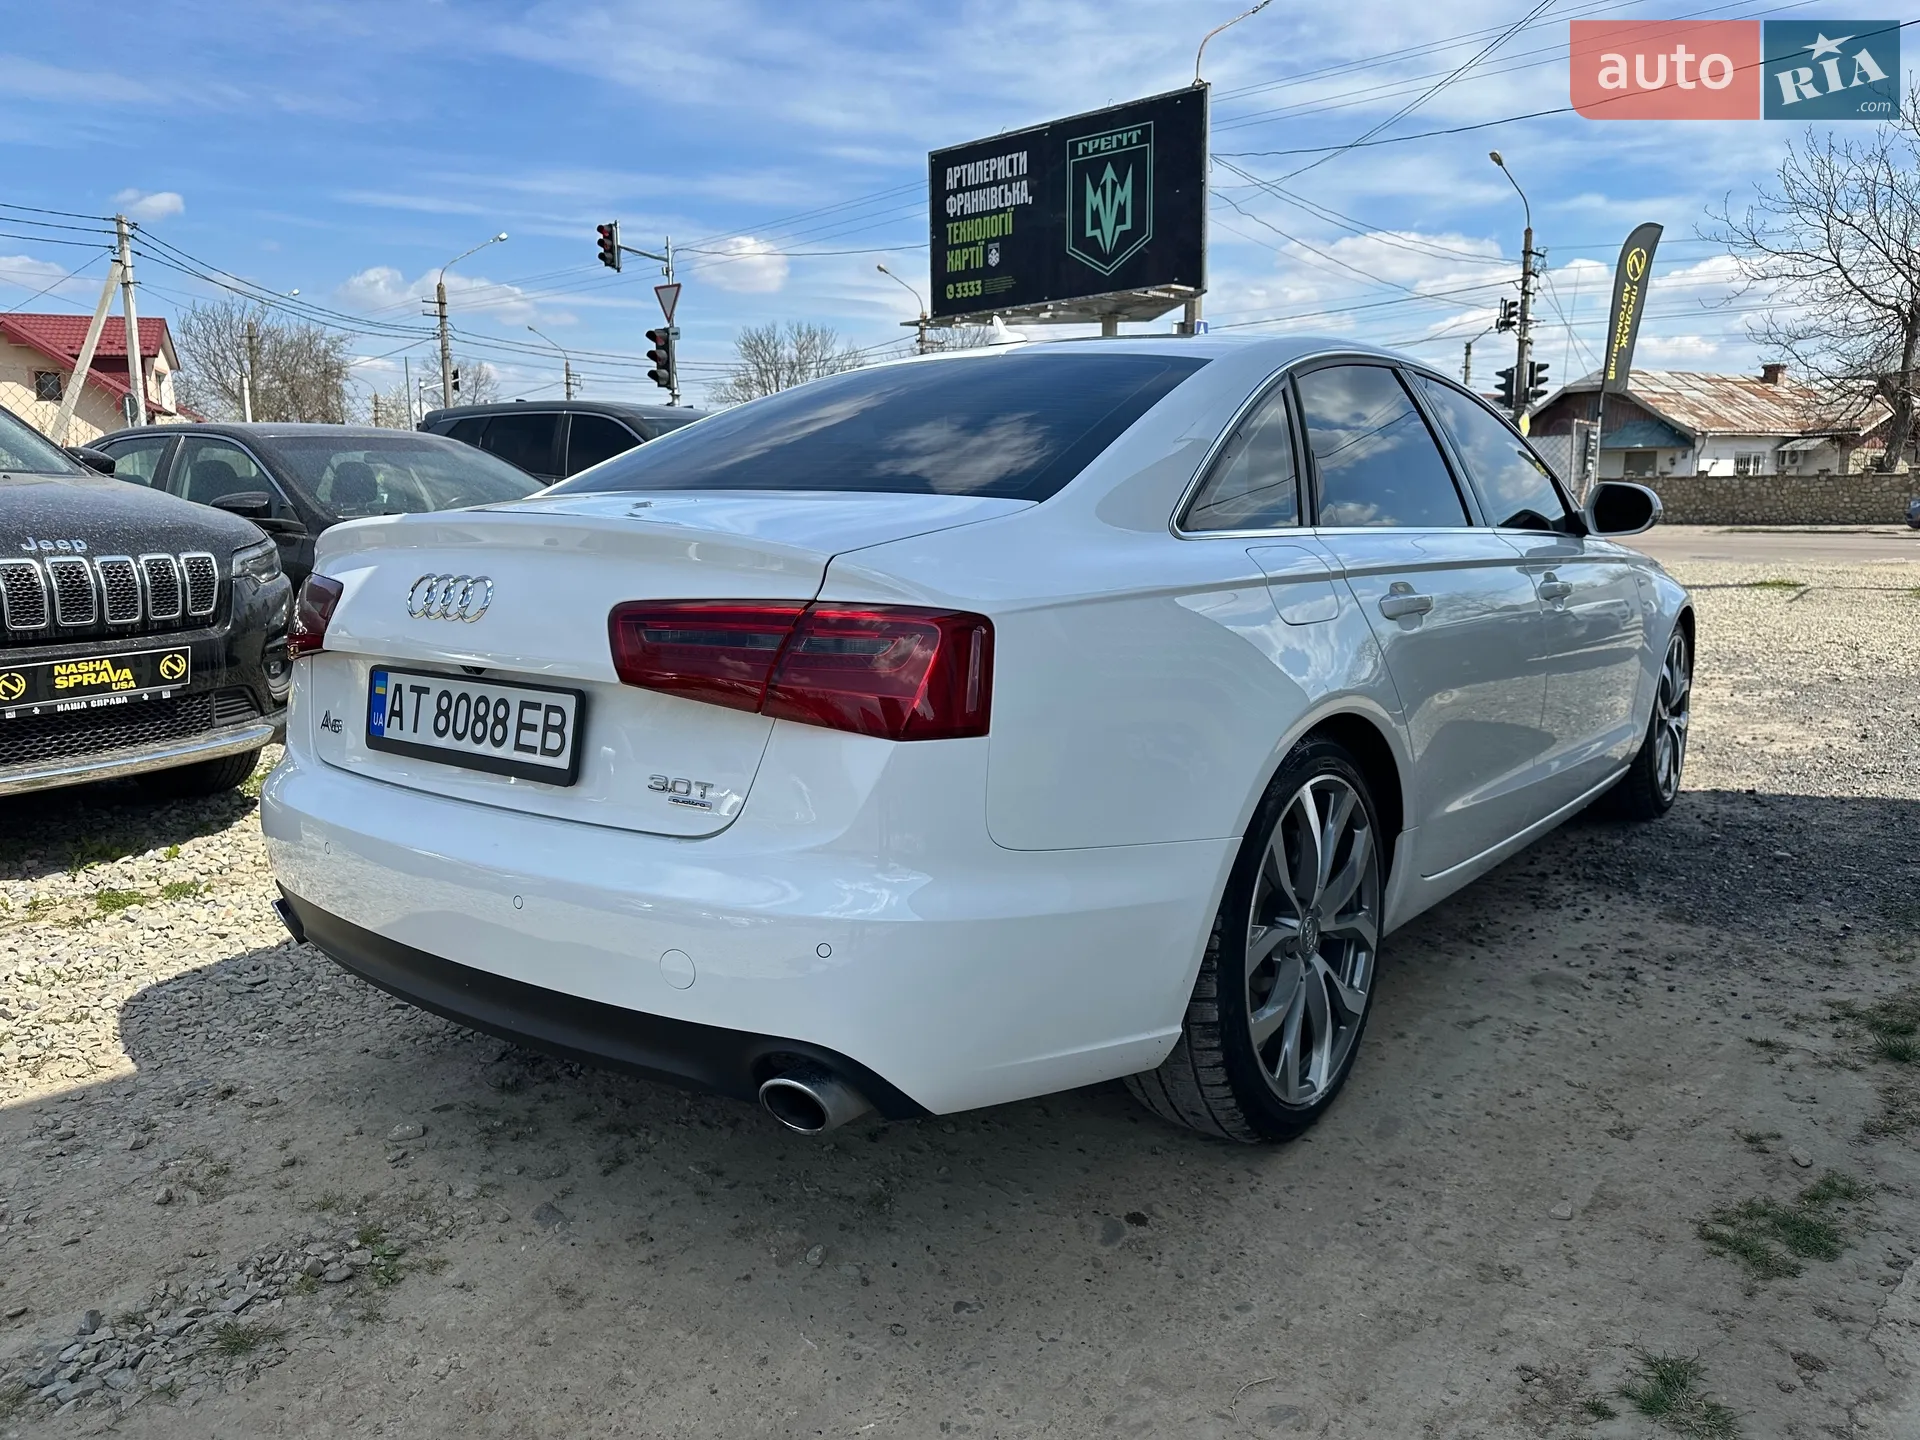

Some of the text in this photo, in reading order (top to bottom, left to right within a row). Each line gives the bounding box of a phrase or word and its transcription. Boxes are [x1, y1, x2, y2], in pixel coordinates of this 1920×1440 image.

[945, 150, 1028, 191] АРТИЛЕРИСТИ
[945, 180, 1033, 217] ФРАНКІВСЬКА,
[946, 207, 1014, 245] ТЕХНОЛОГІЇ
[946, 241, 985, 273] ХАРТІЇ
[955, 280, 982, 298] 3333
[1619, 284, 1639, 349] ПРОДАЖ
[21, 536, 88, 553] Jeep
[53, 659, 112, 676] NASHA
[54, 668, 134, 689] SPRAVA
[111, 681, 136, 691] USA
[56, 701, 87, 712] НАША
[373, 711, 384, 727] UA
[386, 683, 567, 758] AT 8088 EB
